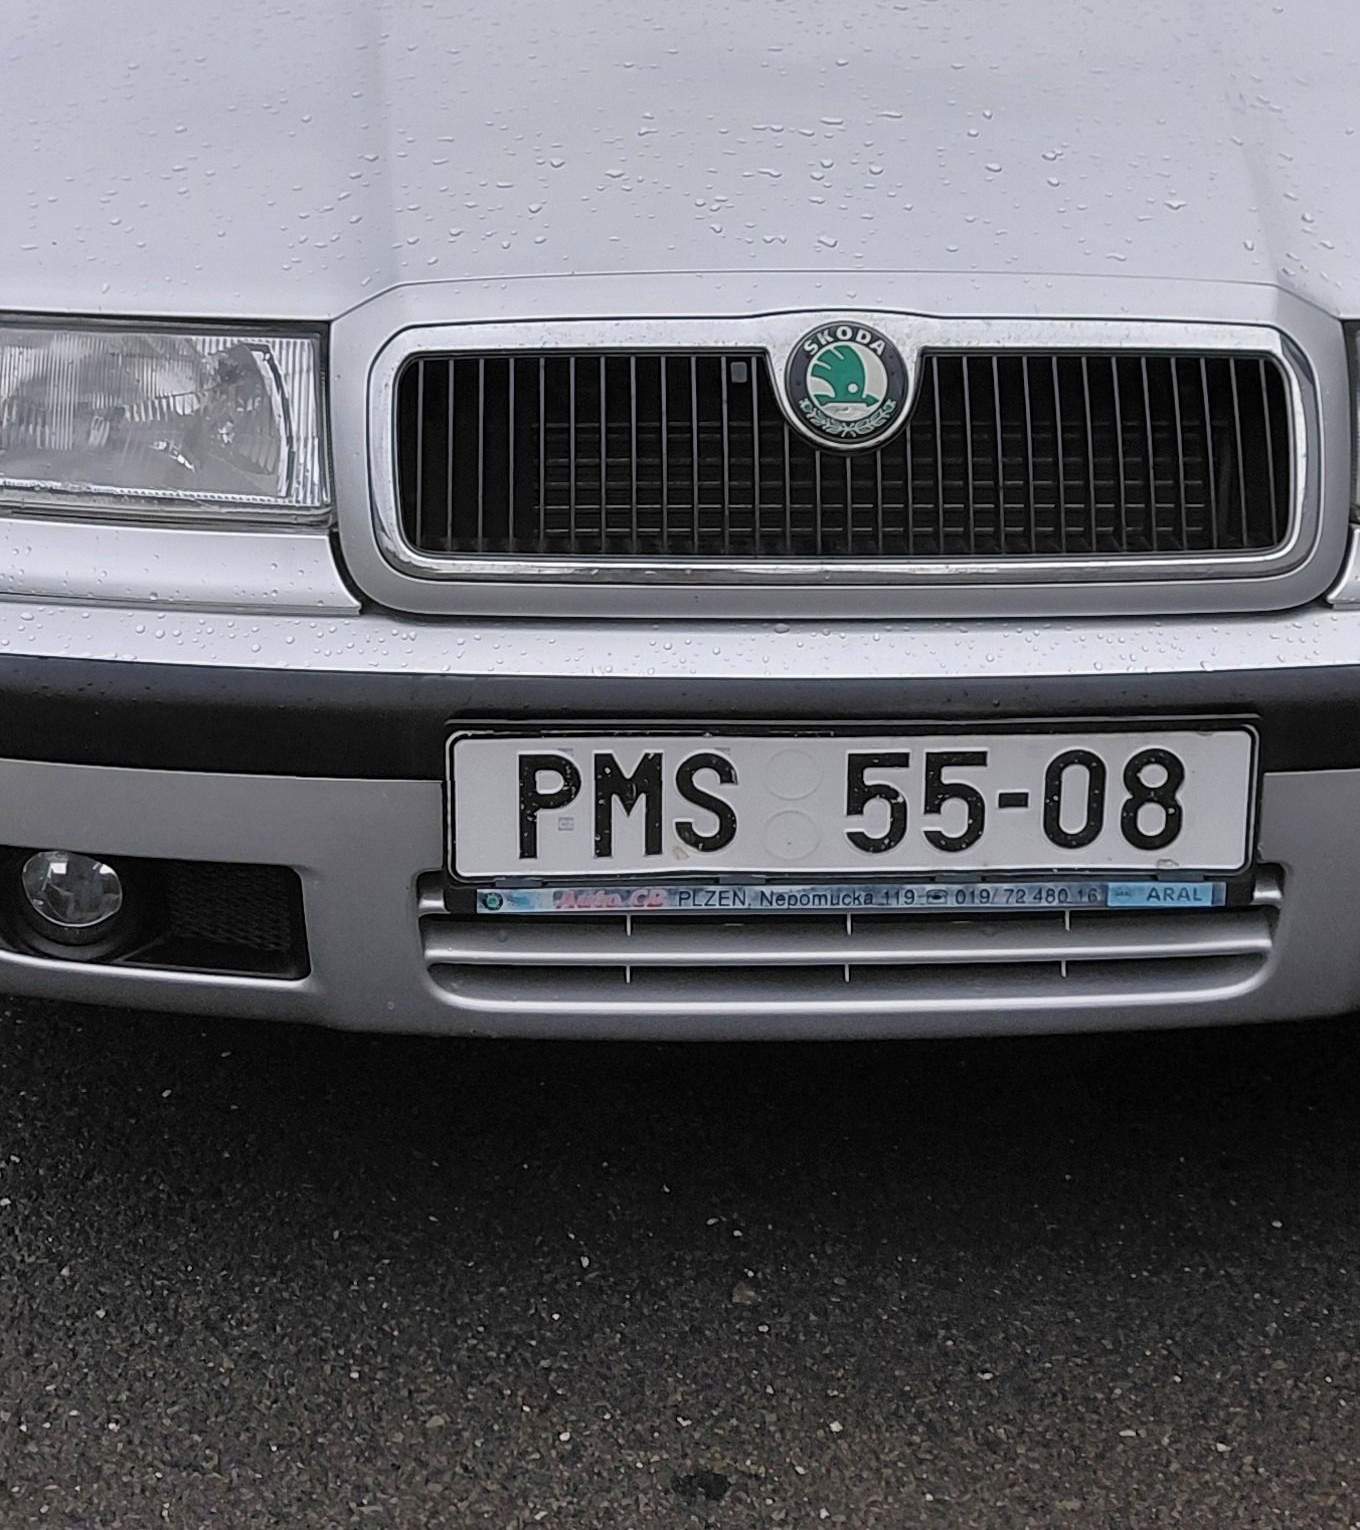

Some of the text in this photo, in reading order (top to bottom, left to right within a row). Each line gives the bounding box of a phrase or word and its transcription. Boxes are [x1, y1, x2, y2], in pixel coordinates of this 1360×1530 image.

[518, 748, 1185, 859] PMS 55-08
[884, 889, 915, 905] 119
[1004, 889, 1026, 904] 72
[1033, 887, 1068, 904] 480
[1146, 884, 1203, 902] ARAL
